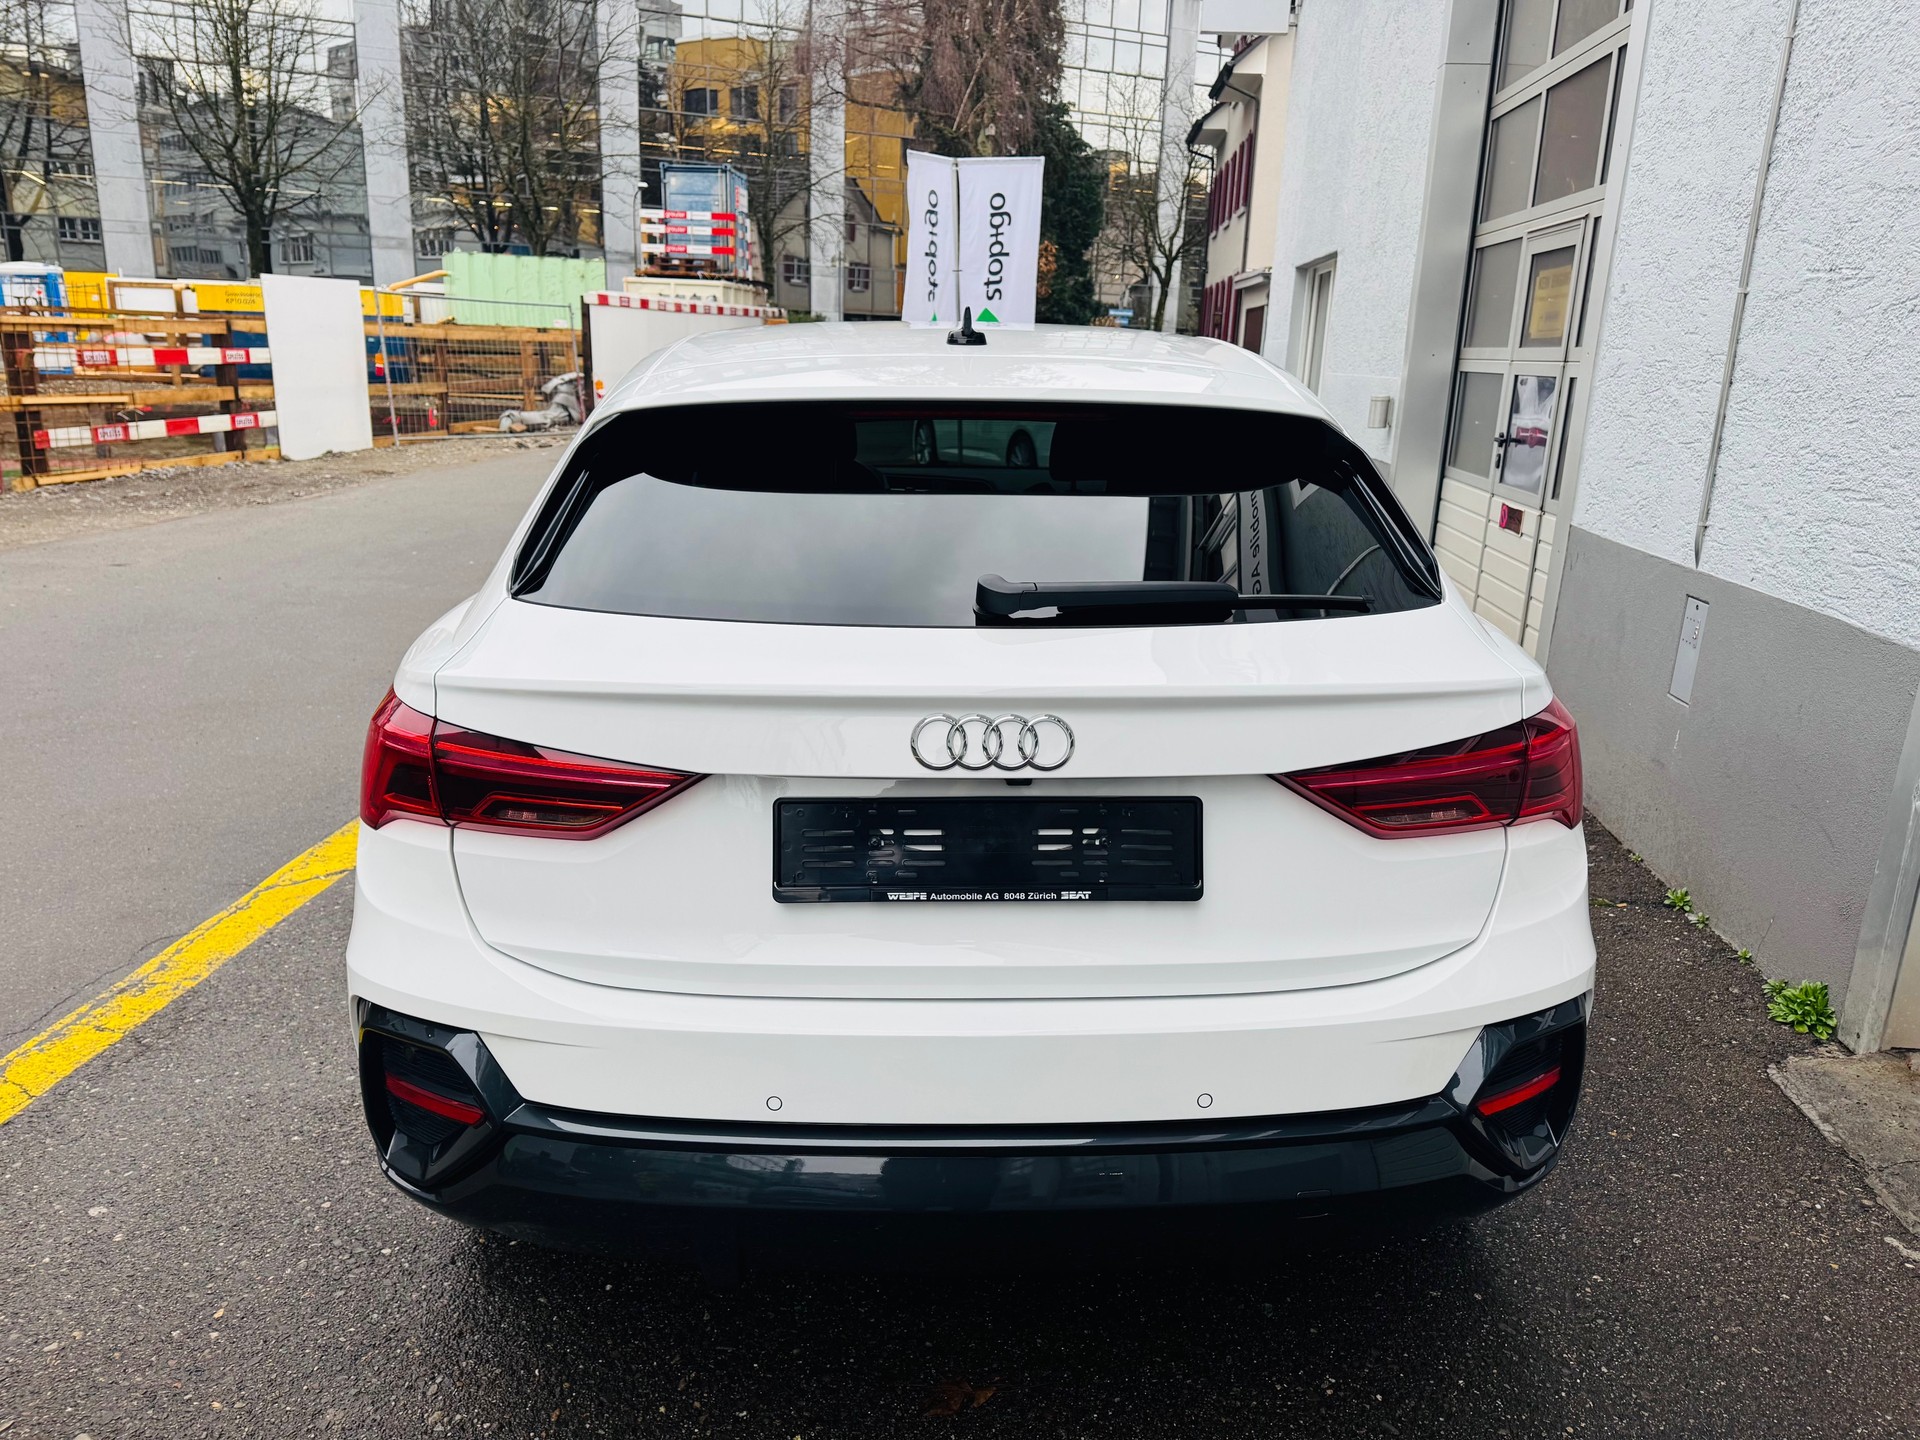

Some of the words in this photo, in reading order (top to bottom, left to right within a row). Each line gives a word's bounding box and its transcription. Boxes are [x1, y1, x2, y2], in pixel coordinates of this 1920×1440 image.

[983, 192, 1012, 301] stop+go
[887, 892, 927, 900] WESPE
[929, 892, 983, 900] Automobile
[984, 892, 999, 900] AG
[1003, 892, 1026, 900] 8048
[1027, 891, 1057, 900] Zürich
[1060, 891, 1092, 899] SEAT
